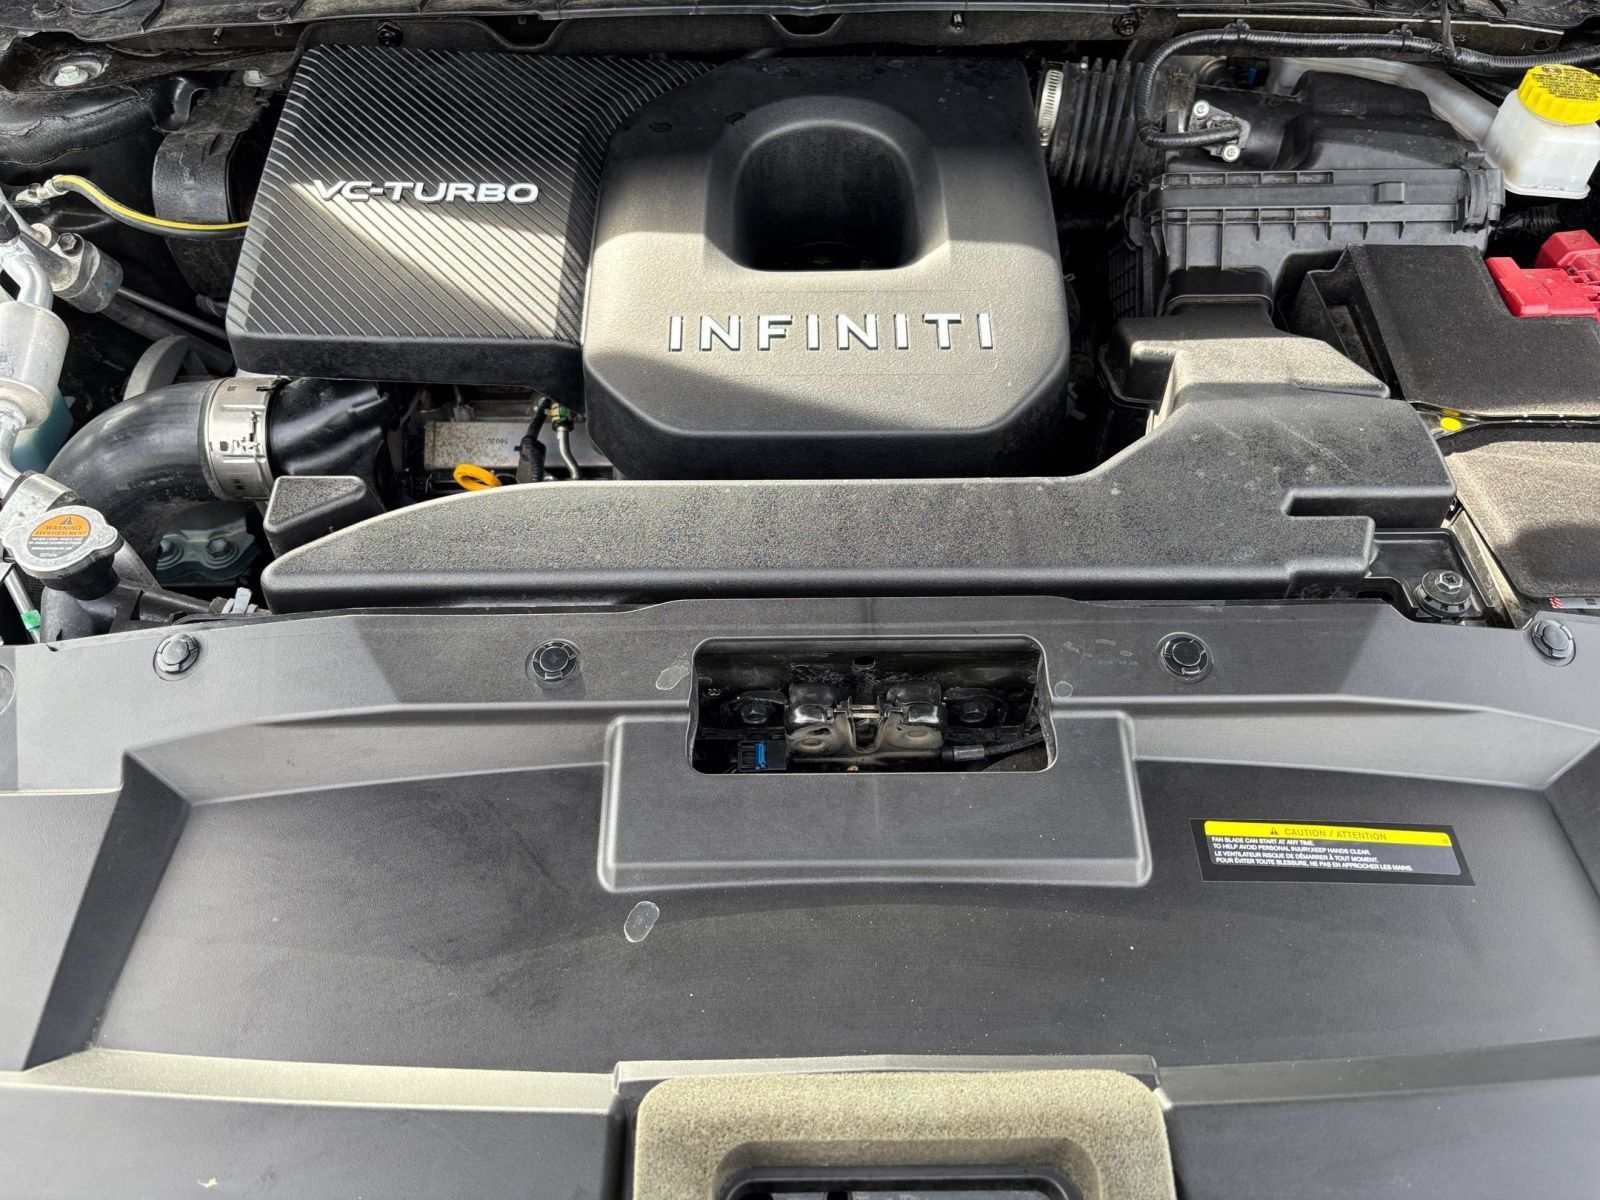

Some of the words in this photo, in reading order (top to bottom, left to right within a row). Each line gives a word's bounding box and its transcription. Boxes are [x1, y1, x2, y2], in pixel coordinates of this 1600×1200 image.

[313, 180, 539, 204] VC-TURBO
[669, 314, 994, 351] INFINITI
[1284, 828, 1326, 837] CAUTION
[1337, 830, 1387, 840] ATTENTION
